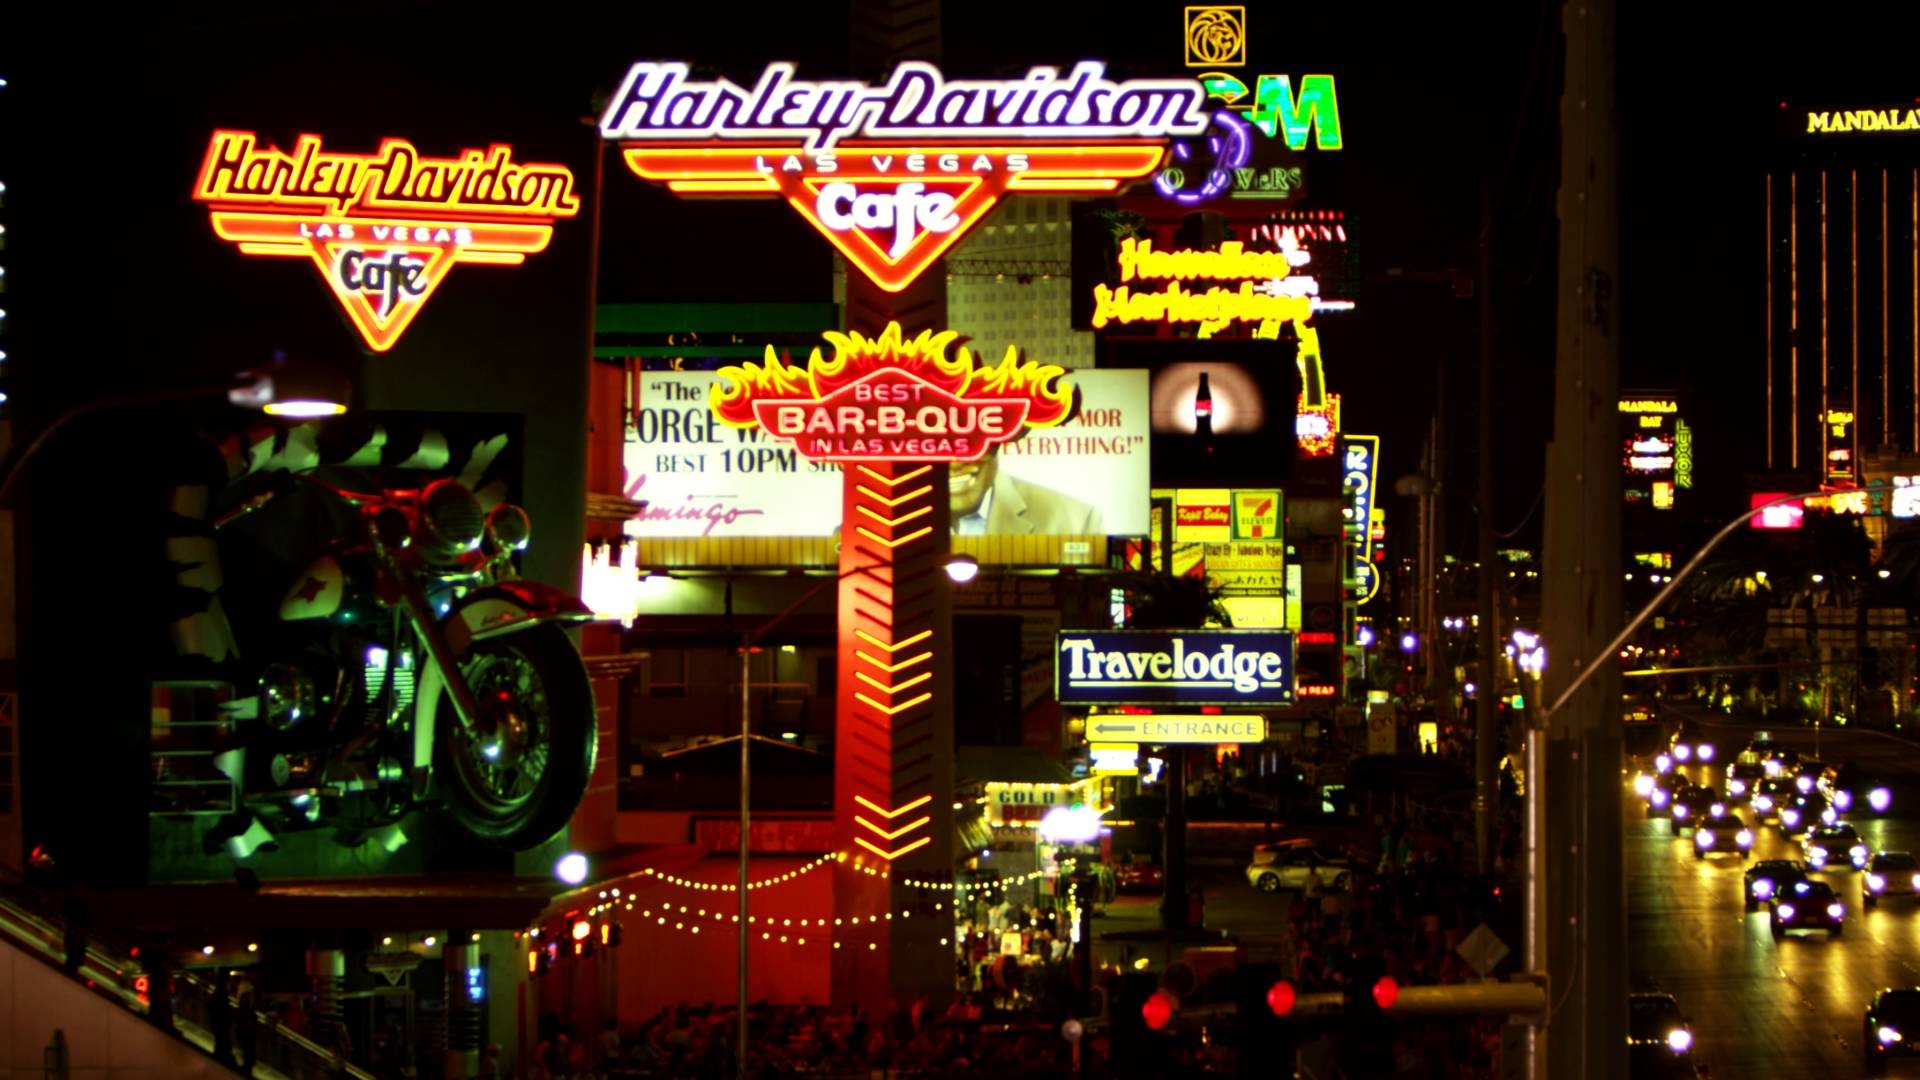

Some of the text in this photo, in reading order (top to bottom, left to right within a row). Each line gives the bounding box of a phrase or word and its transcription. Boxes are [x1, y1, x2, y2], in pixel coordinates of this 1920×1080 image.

[756, 154, 1030, 173] LAS VEGAS
[816, 181, 961, 258] Cafe
[300, 223, 473, 245] LAS VEGAS
[335, 246, 430, 322] Cafe
[855, 384, 925, 401] BEST
[625, 408, 724, 443] ORGE
[777, 406, 1003, 435] BAR-B-QUE
[1076, 408, 1121, 427] MOR
[810, 438, 969, 454] IN LAS VEGAS
[656, 454, 707, 473] BEST
[720, 448, 797, 473] 10PM
[1061, 638, 1282, 692] Travelodge
[1142, 722, 1257, 735] ENTRANCE
